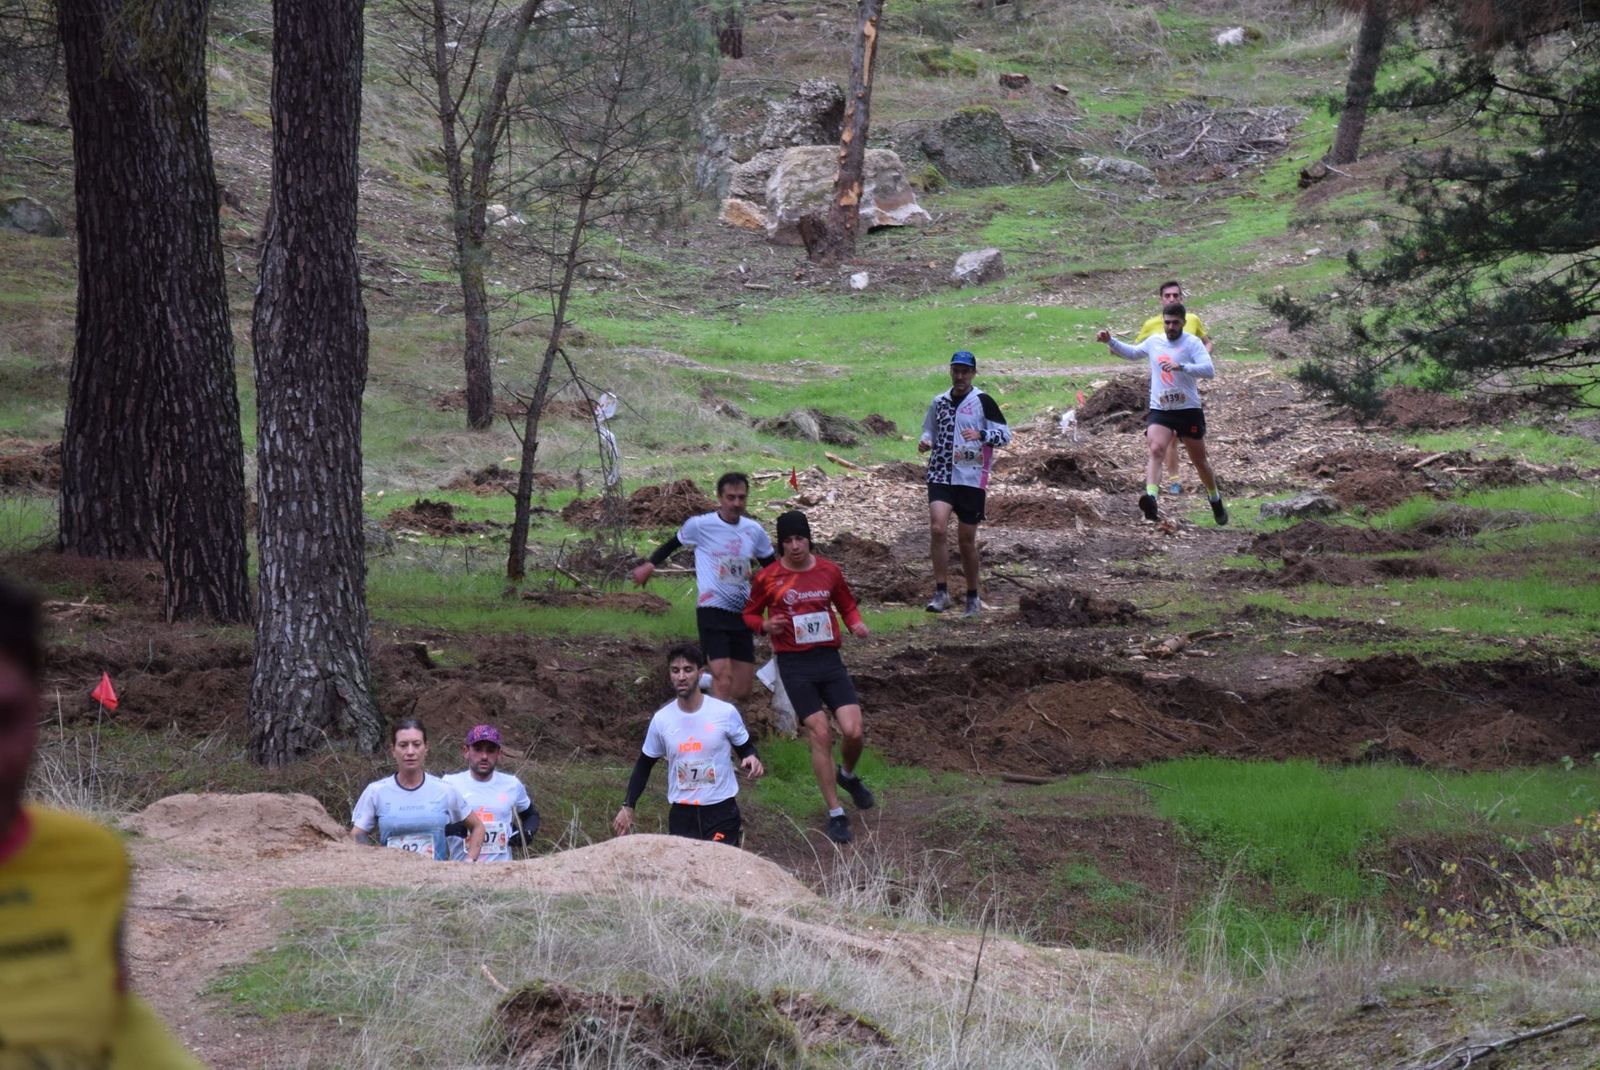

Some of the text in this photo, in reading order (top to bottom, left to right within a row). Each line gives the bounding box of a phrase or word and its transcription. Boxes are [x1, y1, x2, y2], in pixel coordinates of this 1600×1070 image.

[1166, 393, 1179, 403] 139
[964, 450, 975, 460] 13
[807, 622, 820, 633] 87
[691, 769, 698, 779] 7
[482, 831, 498, 843] 07
